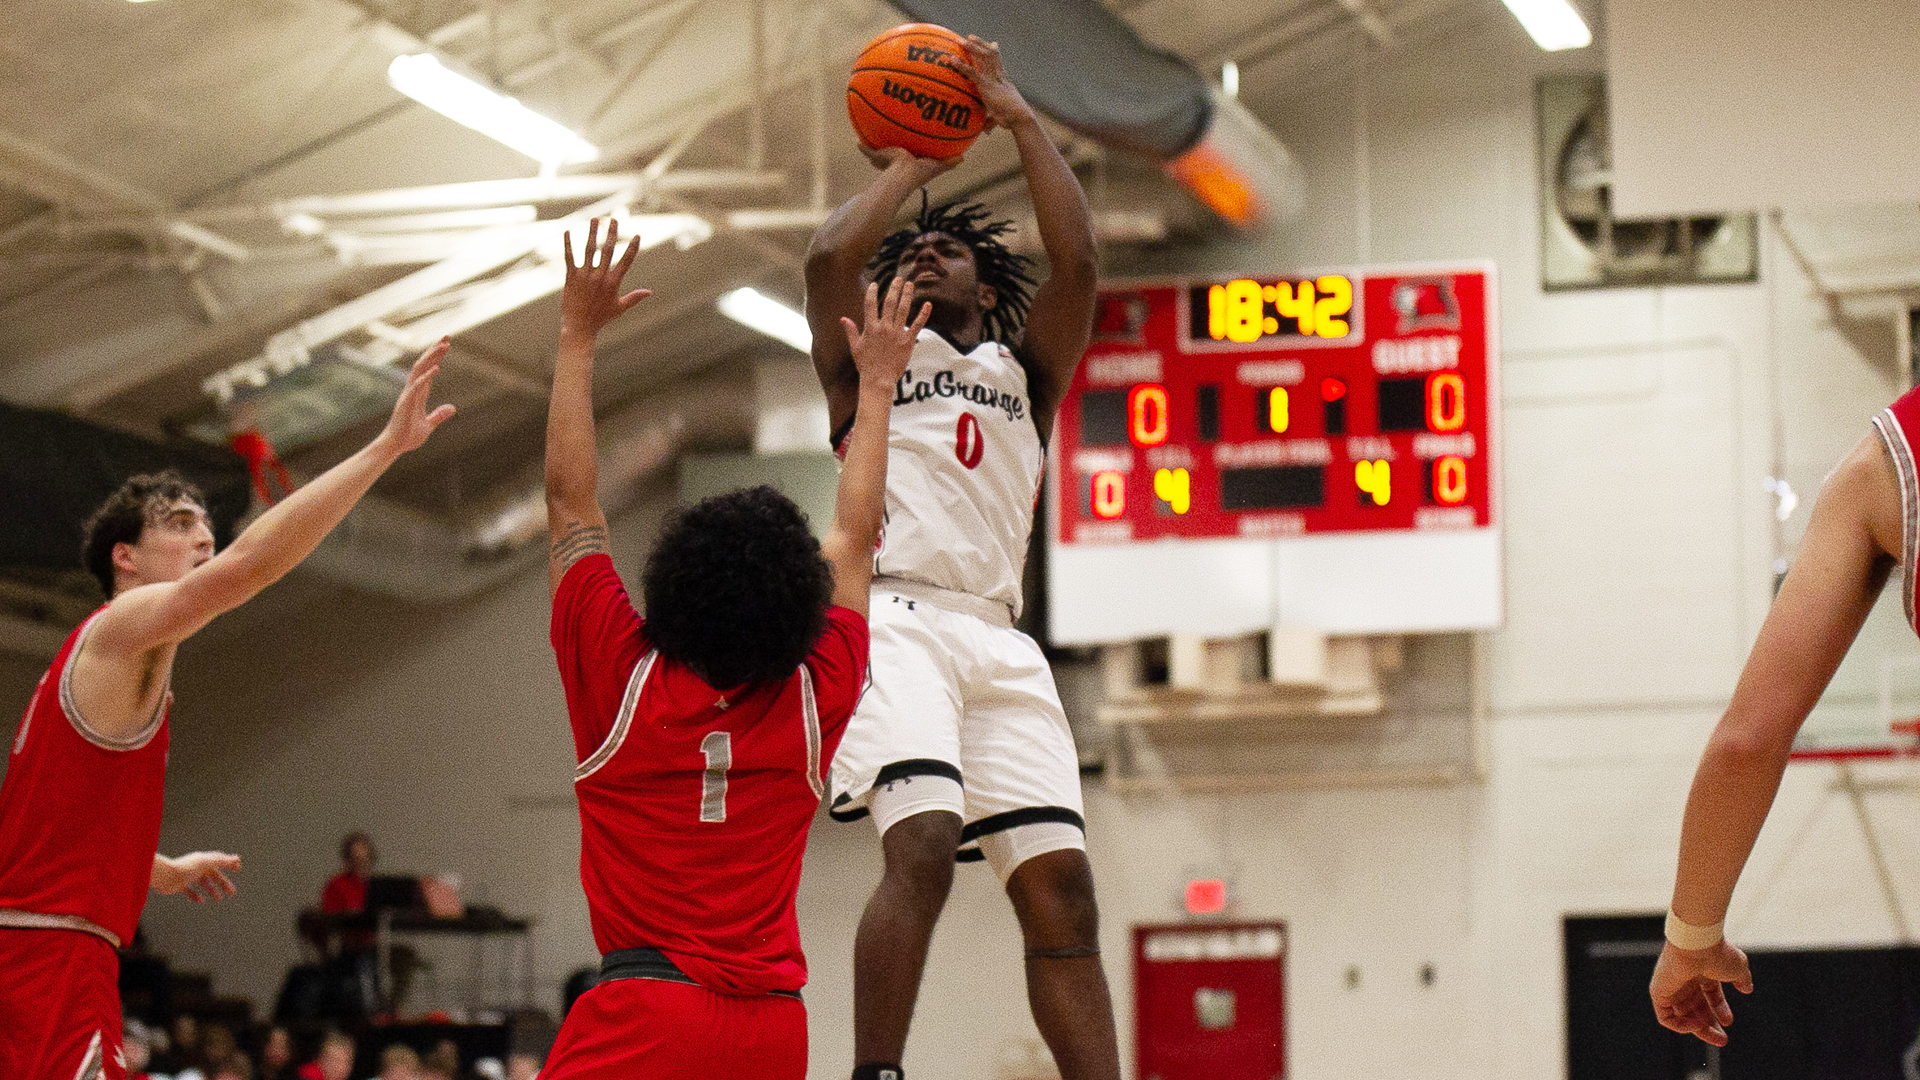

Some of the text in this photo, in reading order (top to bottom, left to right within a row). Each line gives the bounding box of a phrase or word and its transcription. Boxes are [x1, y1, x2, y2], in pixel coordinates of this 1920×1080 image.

[881, 78, 971, 130] Wilson
[1208, 275, 1352, 343] 18:42
[893, 369, 1025, 422] LaGrange
[1128, 383, 1169, 449] 0
[1270, 386, 1288, 433] 1
[1425, 369, 1467, 434] 0
[955, 411, 984, 470] 0
[1090, 469, 1127, 520] 0
[1154, 467, 1190, 514] 4
[1355, 459, 1391, 506] 4
[1432, 454, 1468, 507] 0
[700, 731, 732, 823] 1
